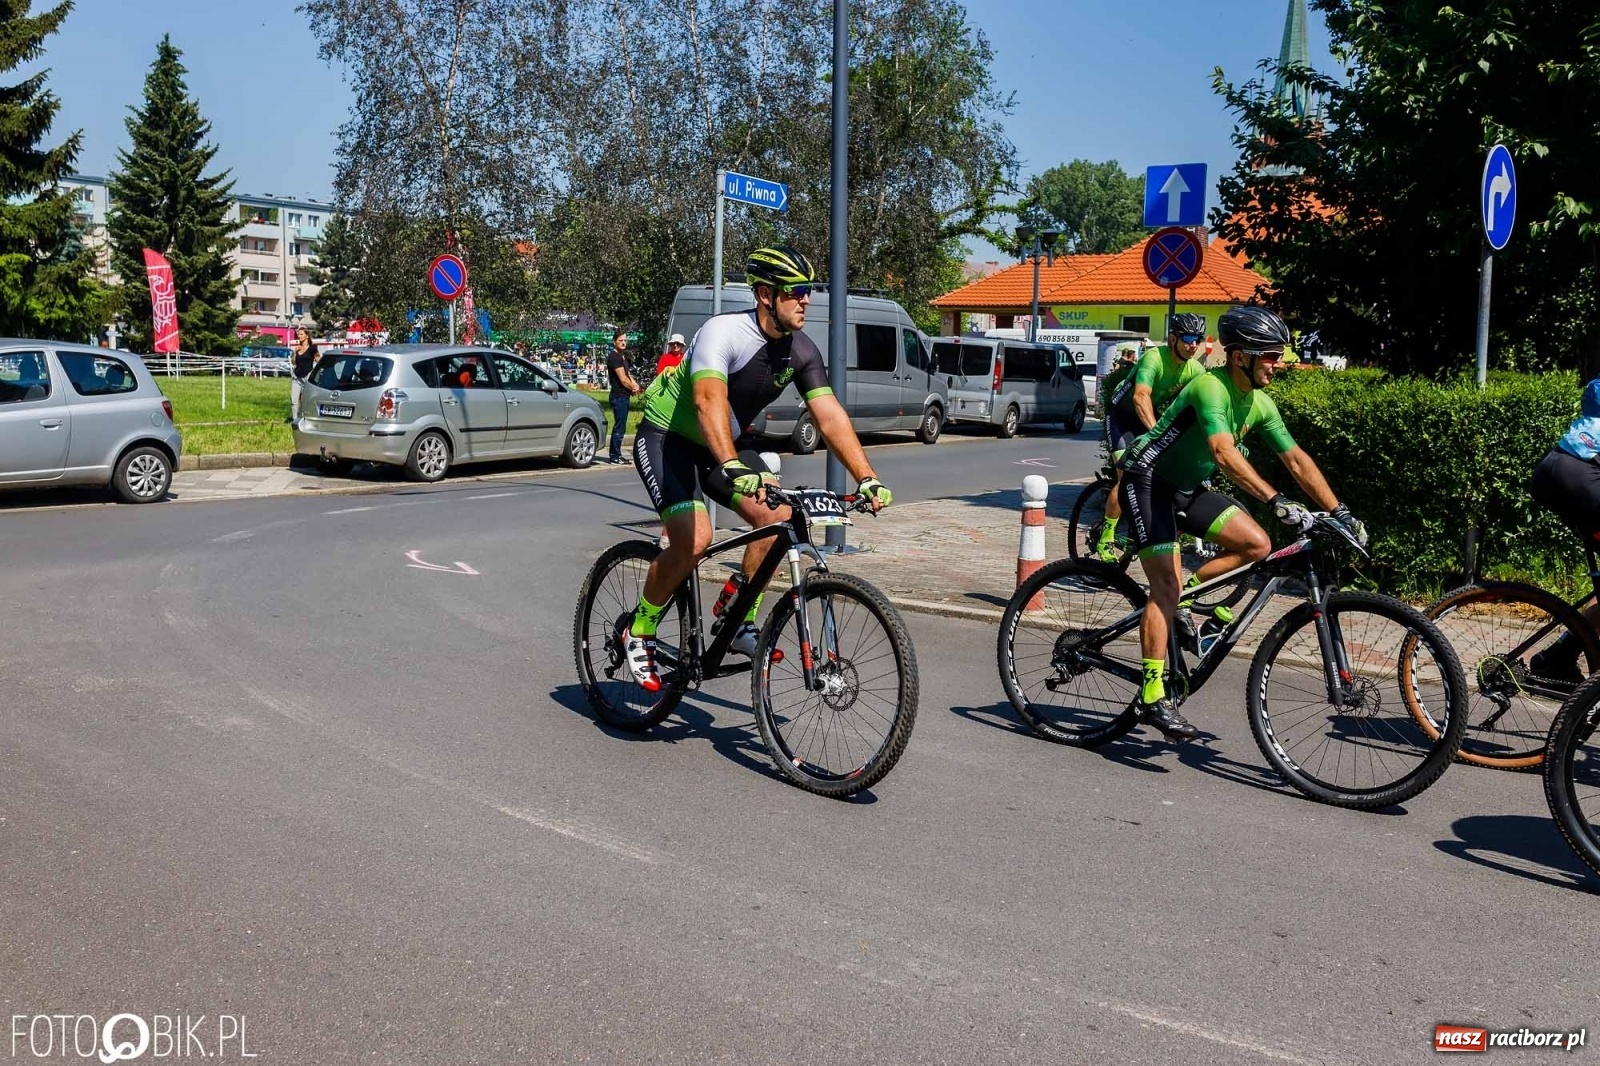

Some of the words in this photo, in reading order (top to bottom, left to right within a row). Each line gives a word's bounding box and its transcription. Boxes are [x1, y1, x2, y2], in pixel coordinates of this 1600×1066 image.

[728, 179, 742, 196] ul.
[745, 180, 776, 202] Piwna
[1059, 311, 1089, 321] SKUP
[1037, 335, 1051, 343] 690
[1052, 335, 1066, 343] 856
[1066, 335, 1080, 343] 858
[637, 437, 652, 477] GMINA
[647, 474, 663, 507] LYSKI
[804, 496, 844, 513] 1623
[1126, 483, 1140, 516] GMINA
[1134, 516, 1148, 543] LYSKI
